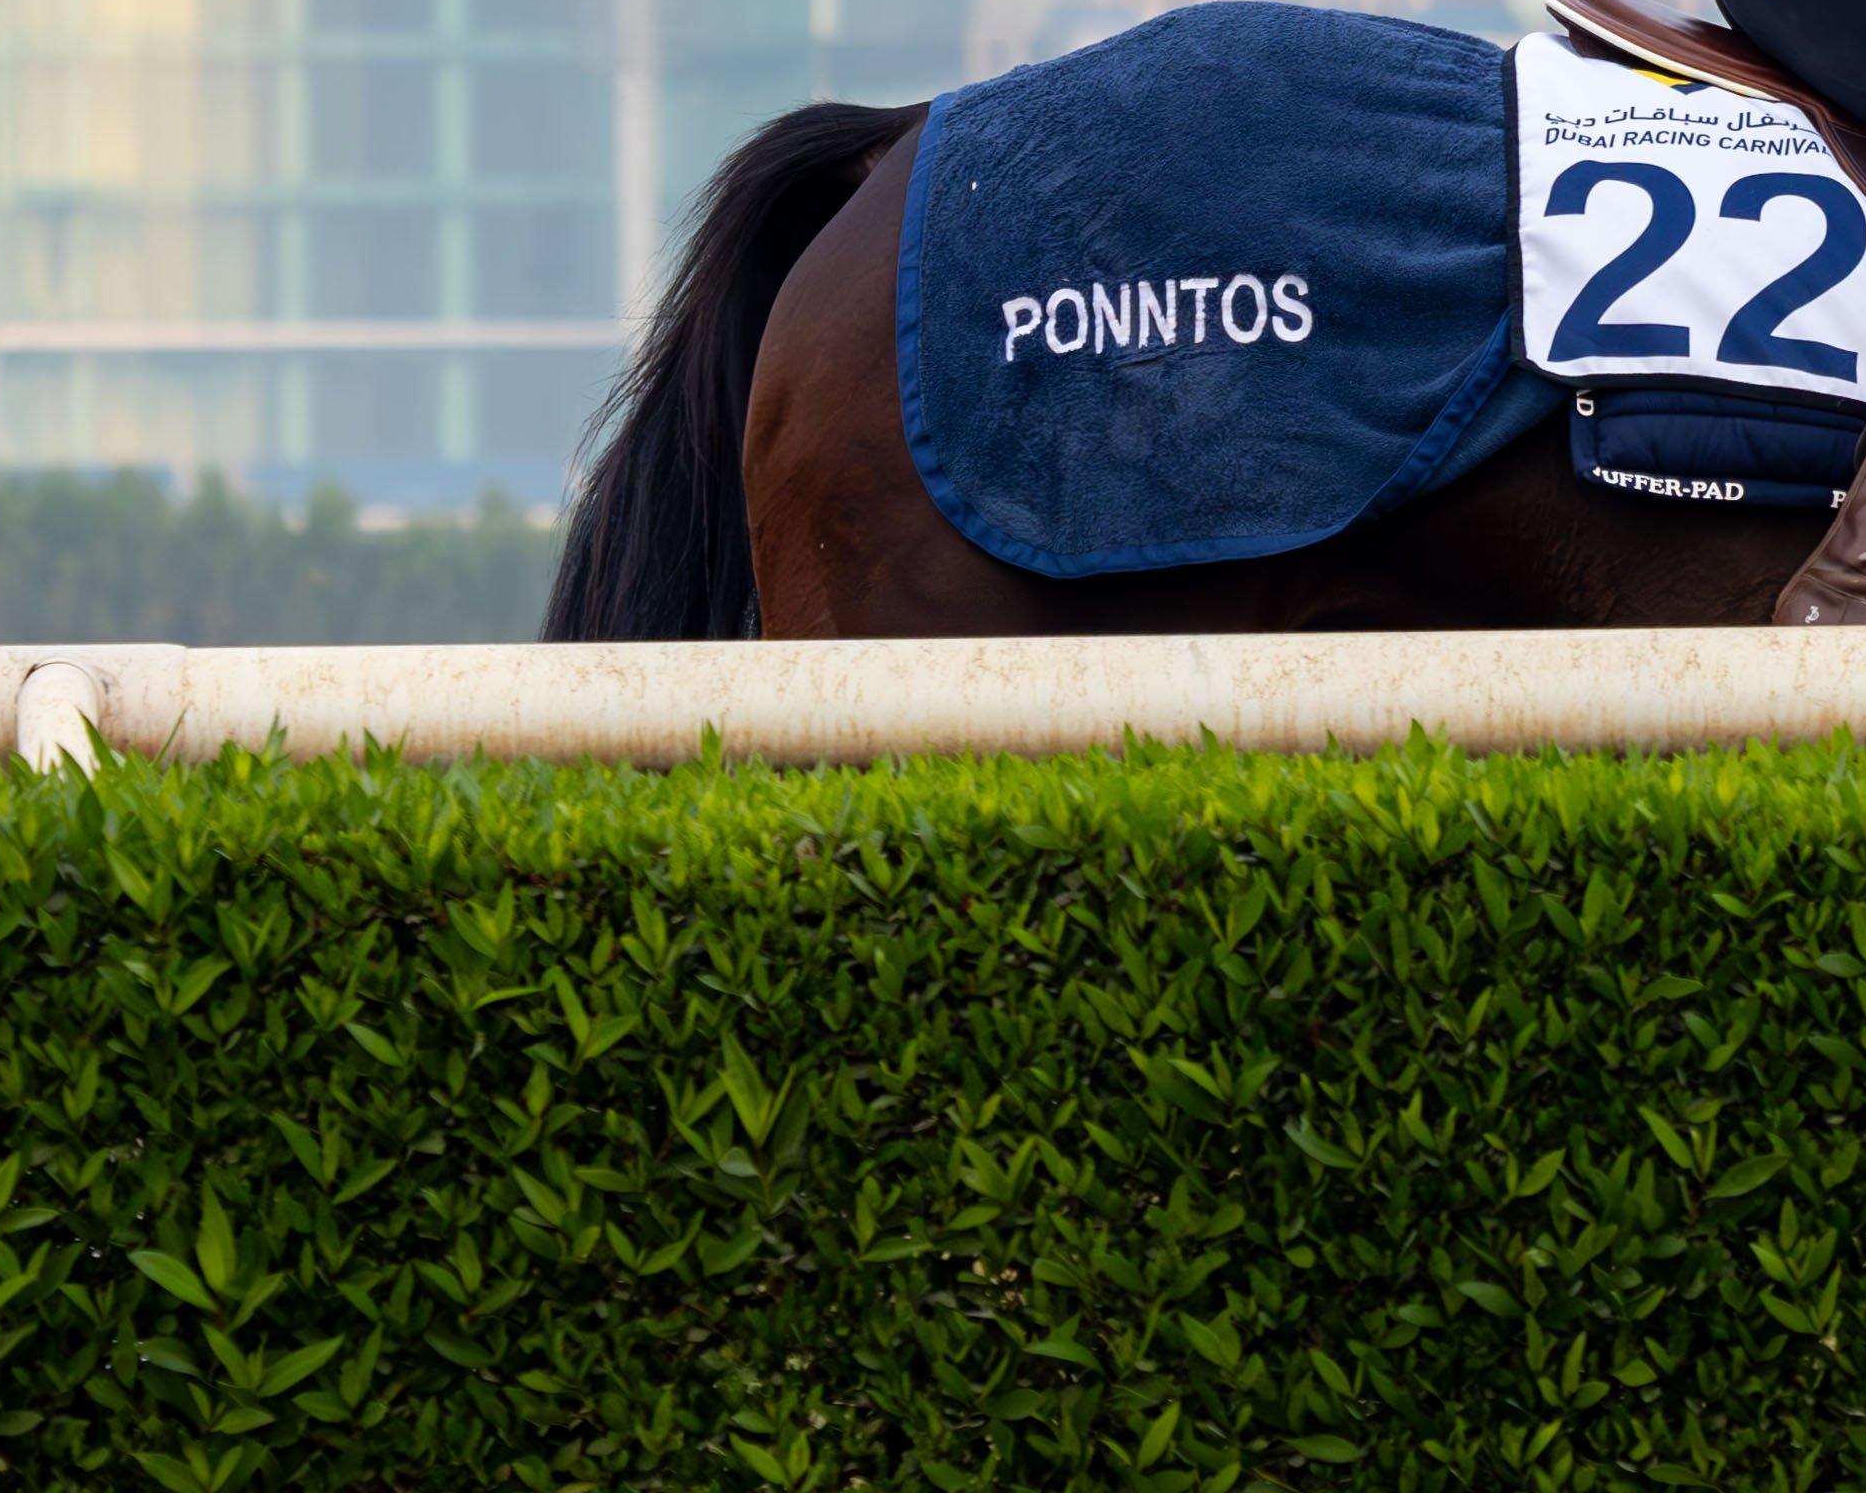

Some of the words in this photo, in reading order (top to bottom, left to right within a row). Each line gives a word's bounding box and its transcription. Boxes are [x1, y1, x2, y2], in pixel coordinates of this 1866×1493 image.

[1545, 112, 1596, 129] دبي
[1604, 106, 1719, 125] سباقات
[1545, 127, 1616, 149] DUBAI
[1622, 130, 1711, 147] RACING
[1000, 272, 1315, 363] PONNTOS
